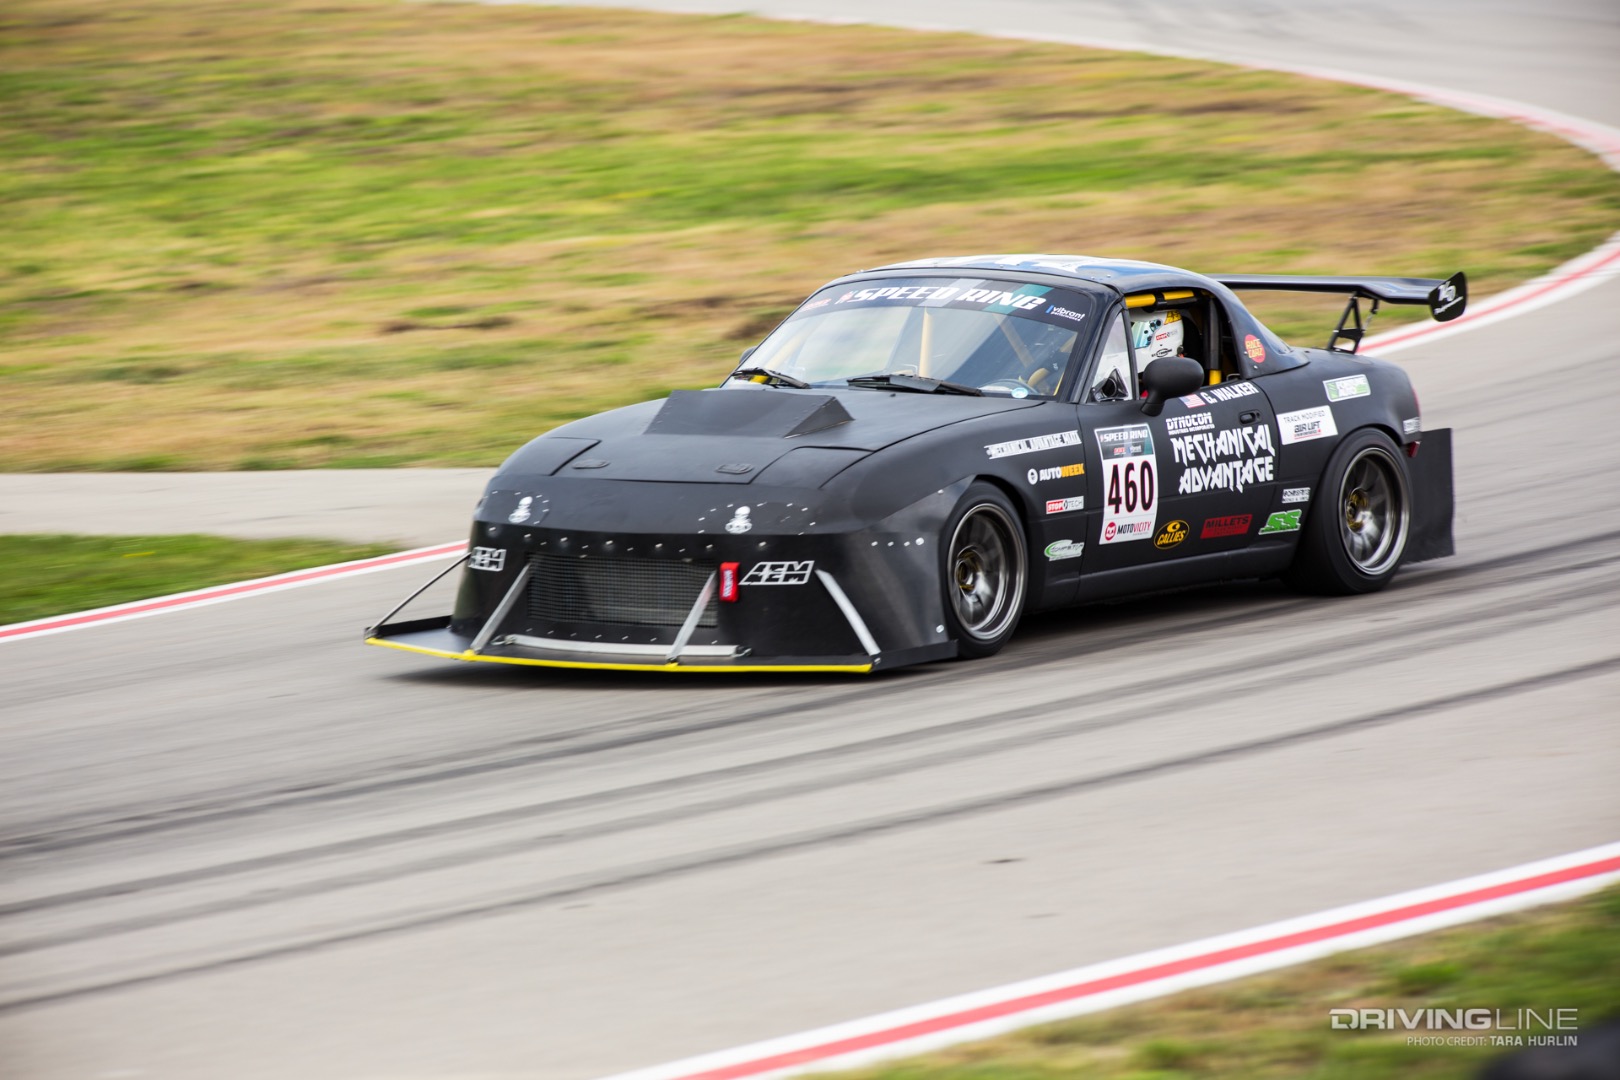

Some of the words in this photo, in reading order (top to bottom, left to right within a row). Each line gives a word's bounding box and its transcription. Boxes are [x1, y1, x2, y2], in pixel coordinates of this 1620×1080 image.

[847, 286, 961, 302] SPEED
[954, 288, 1046, 310] RING
[1052, 306, 1086, 320] vibrant
[1203, 389, 1217, 404] G.
[1216, 381, 1259, 402] WALKER
[1165, 412, 1213, 431] DYNOCOM
[1103, 431, 1129, 443] SPEED
[1170, 424, 1276, 467] MECHANICAL
[1039, 463, 1085, 481] AUTOWEEK
[1179, 456, 1274, 494] ADVANTAGE
[1107, 460, 1155, 515] 460
[1117, 521, 1152, 535] MOTOVICITY
[1205, 516, 1249, 530] MILLETS
[1156, 530, 1187, 547] CALLIES
